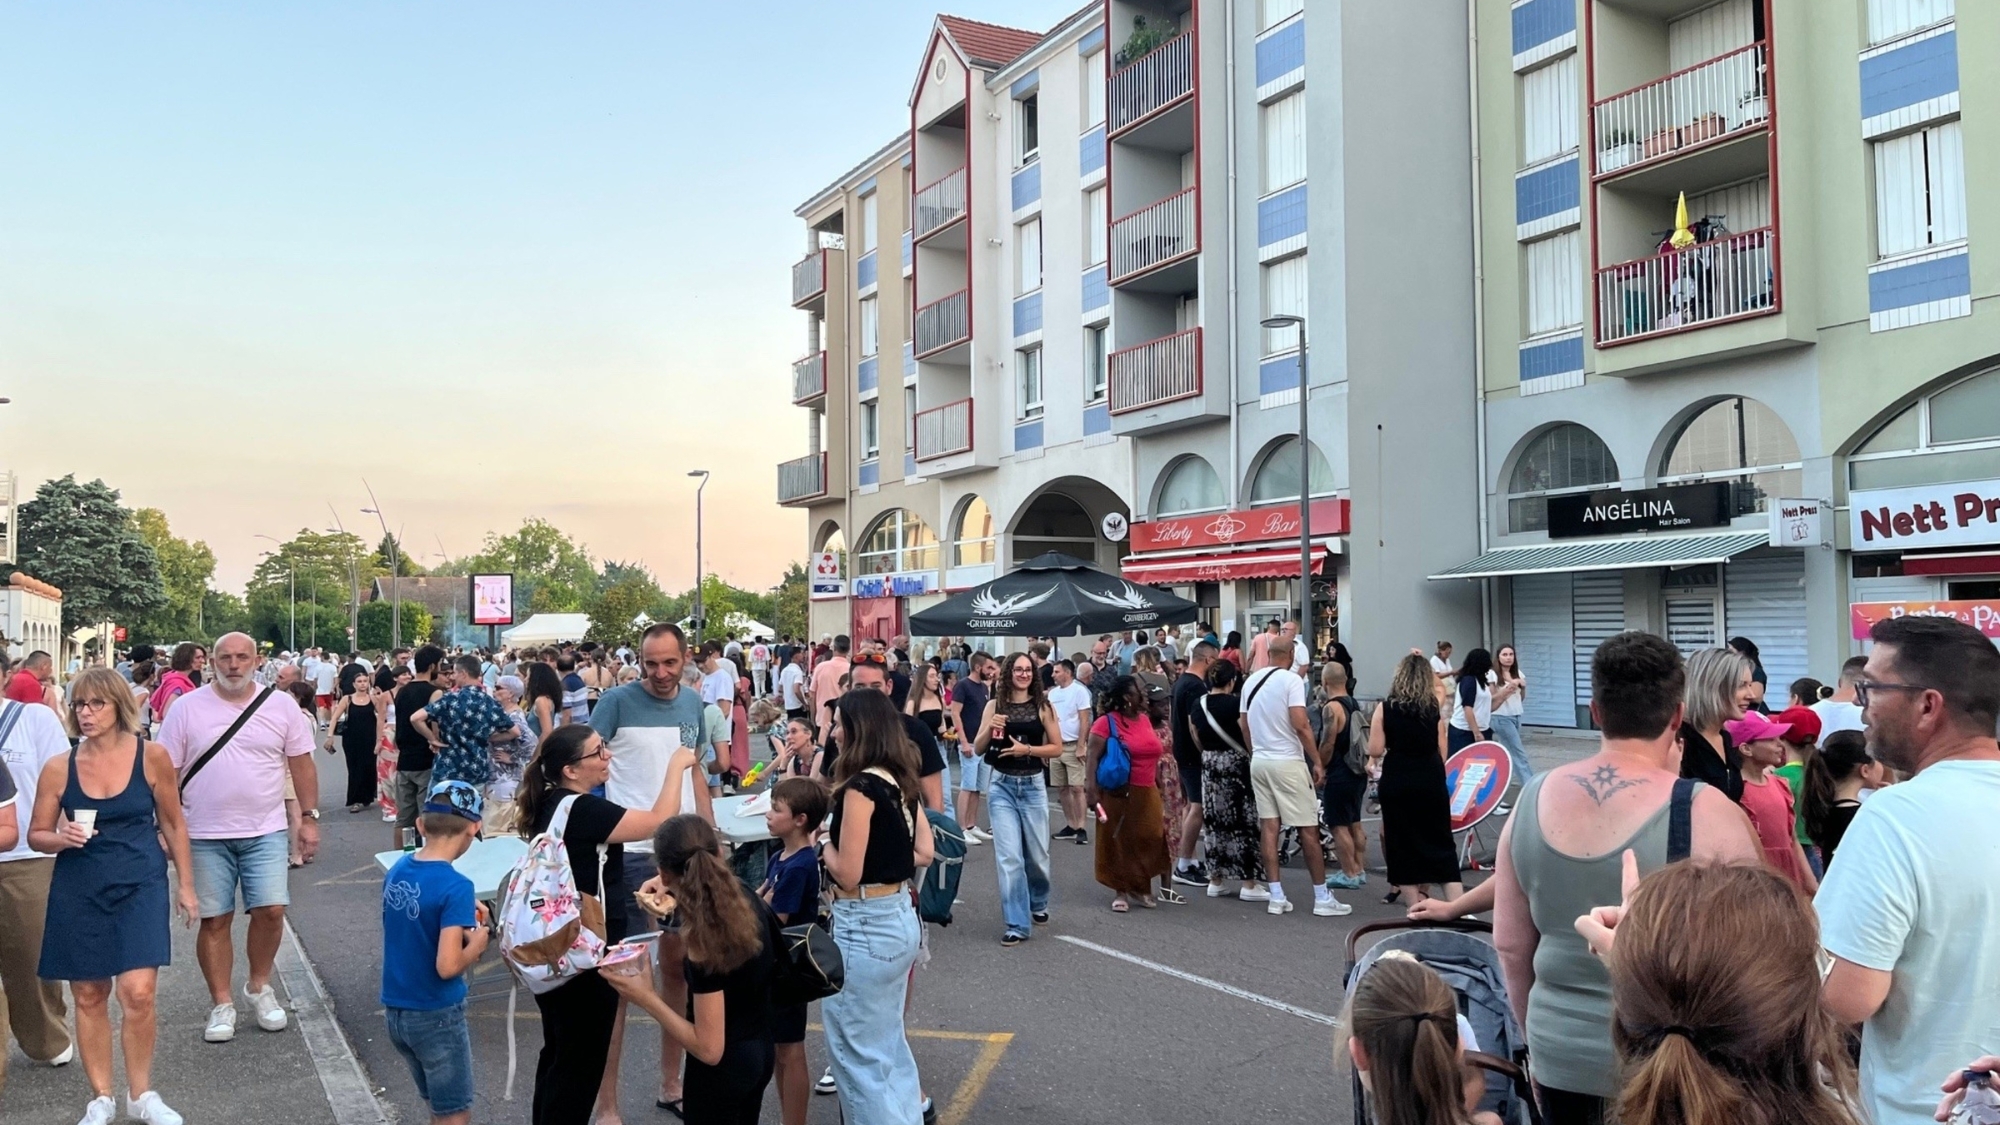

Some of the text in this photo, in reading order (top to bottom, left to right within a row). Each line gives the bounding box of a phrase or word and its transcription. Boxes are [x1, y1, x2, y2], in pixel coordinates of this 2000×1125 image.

[1583, 499, 1675, 522] ANGÉLINA
[1861, 493, 2000, 541] Nett Pr
[1151, 521, 1193, 546] Liberty
[1261, 512, 1299, 534] Bar
[1673, 517, 1691, 525] Salon
[969, 619, 1015, 628] GRIMBERGEN
[1124, 612, 1157, 623] GRIMBERGEN
